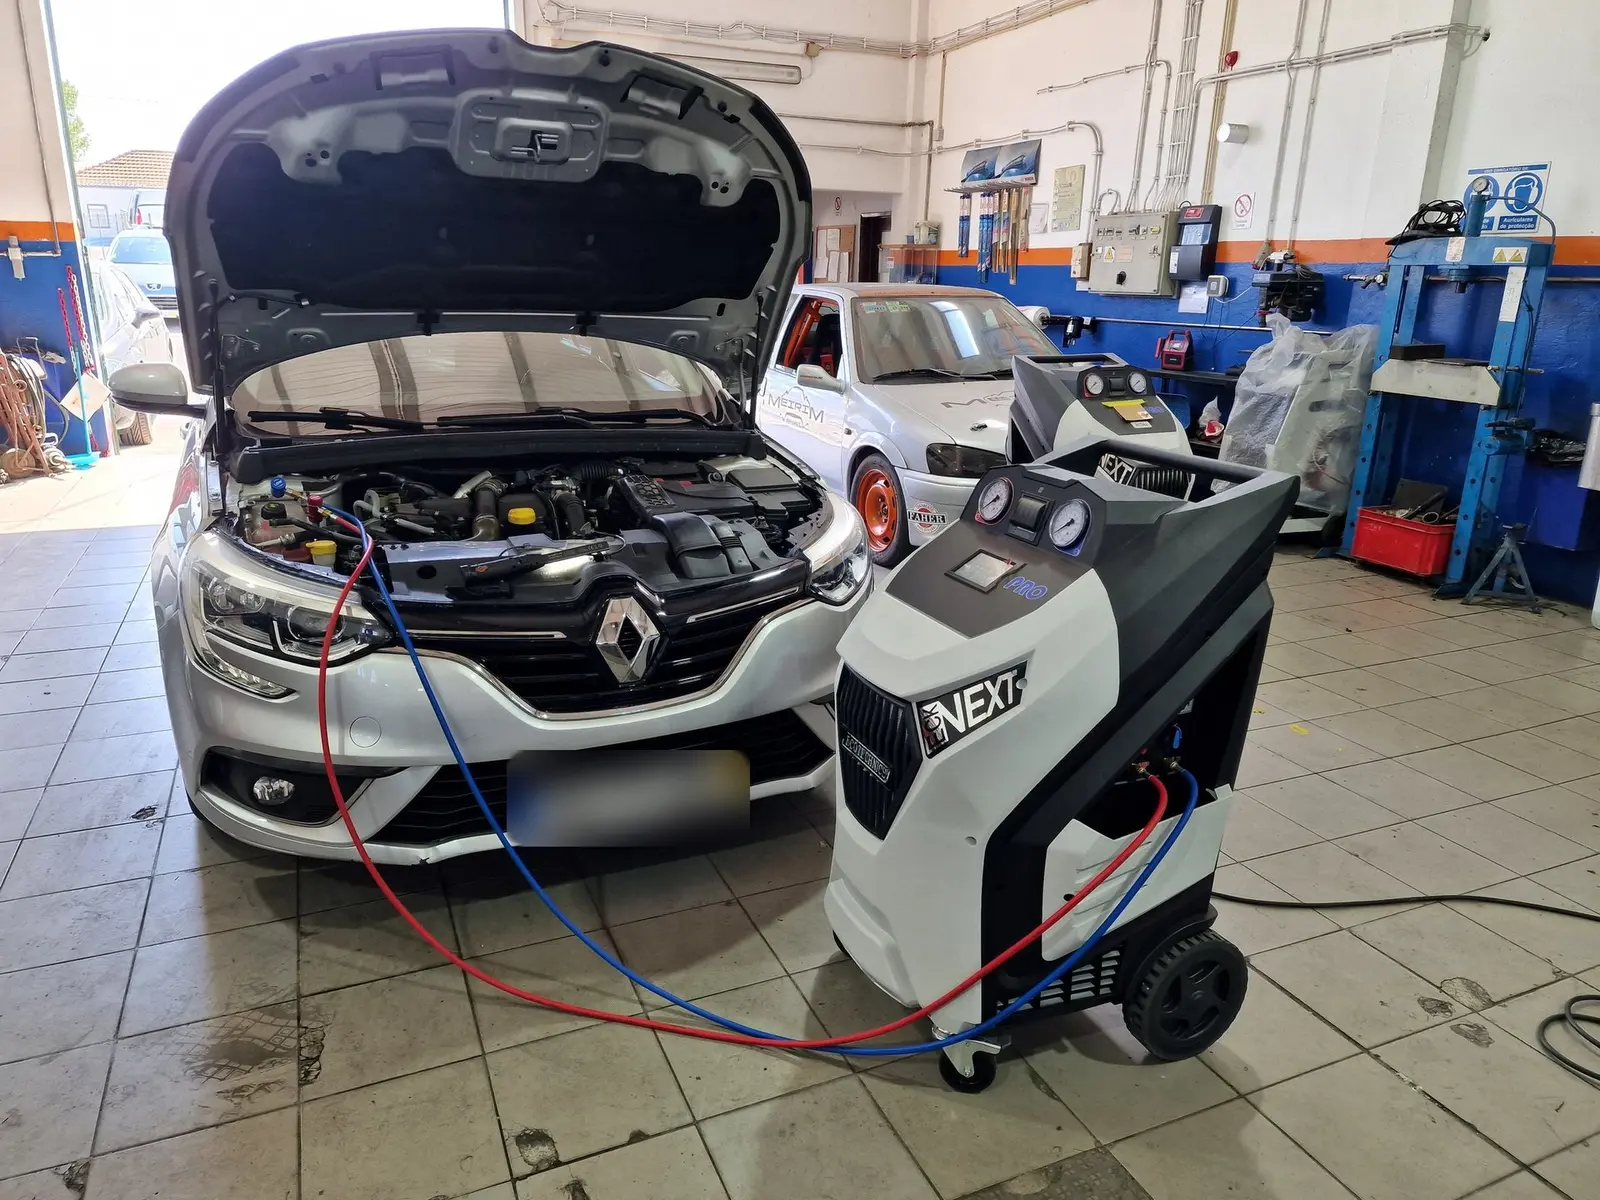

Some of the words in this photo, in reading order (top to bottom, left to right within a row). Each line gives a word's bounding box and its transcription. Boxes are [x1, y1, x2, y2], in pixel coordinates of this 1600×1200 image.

[768, 393, 825, 423] MEIRIM
[1099, 453, 1133, 484] NEXT
[909, 512, 945, 524] FAHER
[1003, 576, 1048, 600] PRO
[922, 669, 1018, 743] NEXT
[845, 734, 889, 779] ECOTECHNICS
